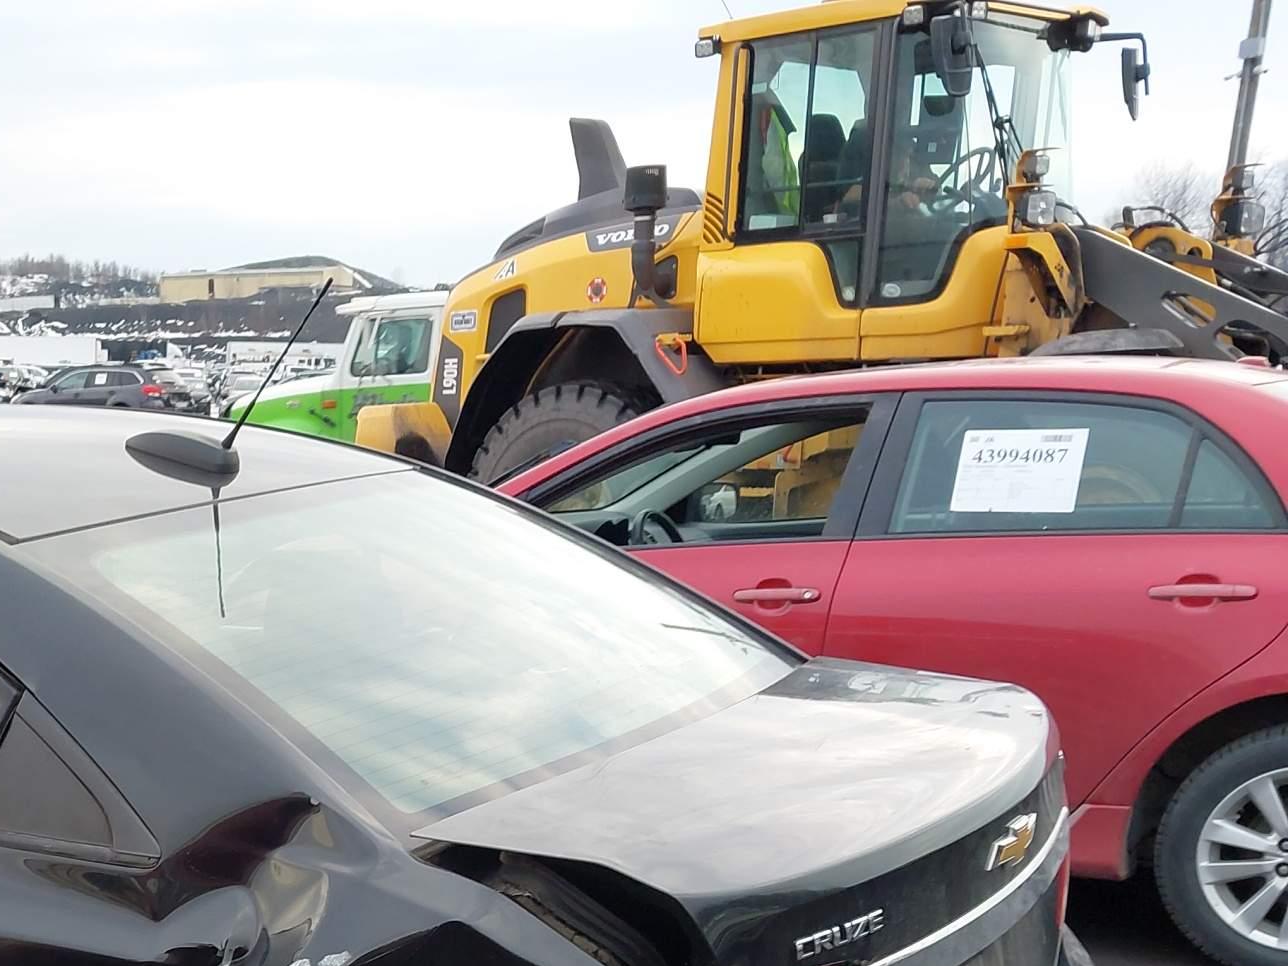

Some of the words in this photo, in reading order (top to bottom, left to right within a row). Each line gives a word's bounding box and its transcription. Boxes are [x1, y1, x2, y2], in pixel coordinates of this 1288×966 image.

[596, 223, 669, 245] VOLO
[442, 358, 459, 395] L90H
[972, 448, 1069, 464] 43994087
[795, 908, 884, 960] CRUZE
